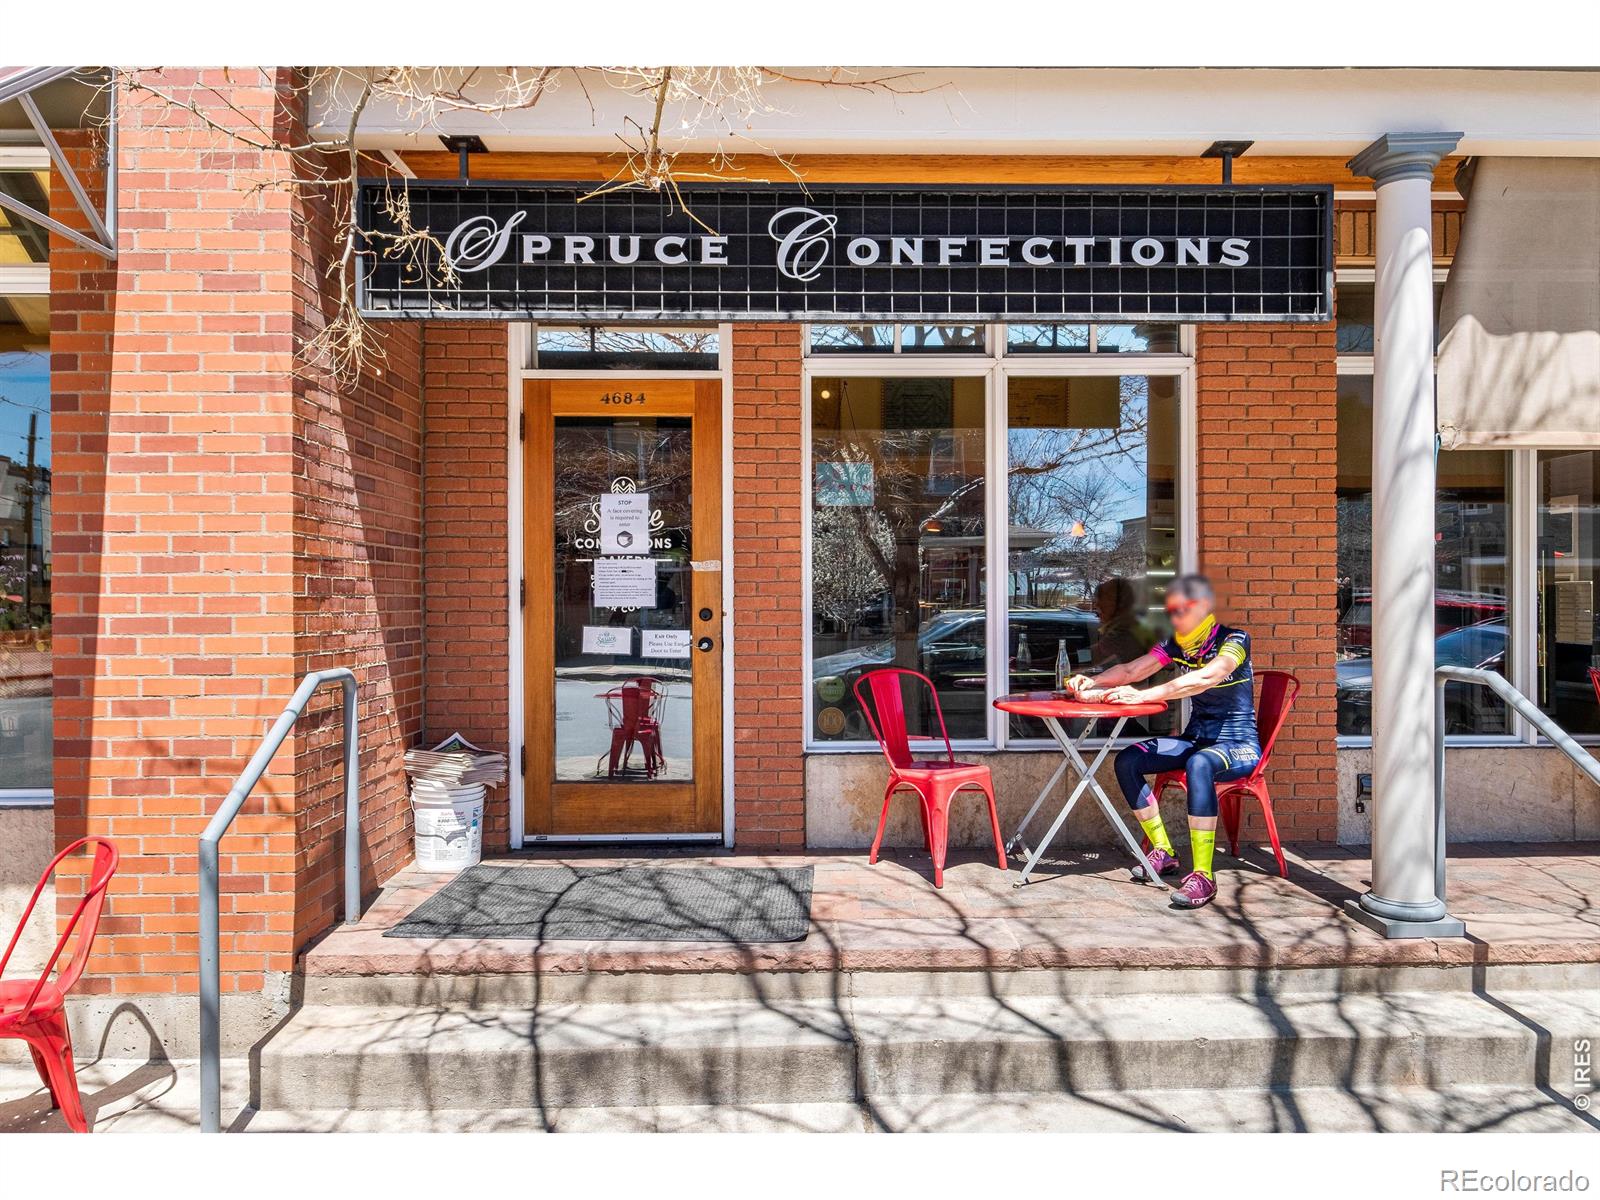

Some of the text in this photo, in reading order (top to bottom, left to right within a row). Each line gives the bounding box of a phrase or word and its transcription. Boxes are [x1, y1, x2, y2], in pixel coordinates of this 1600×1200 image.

[445, 207, 1251, 282] SPRUCE CONFECTIONS
[600, 392, 646, 404] 4684
